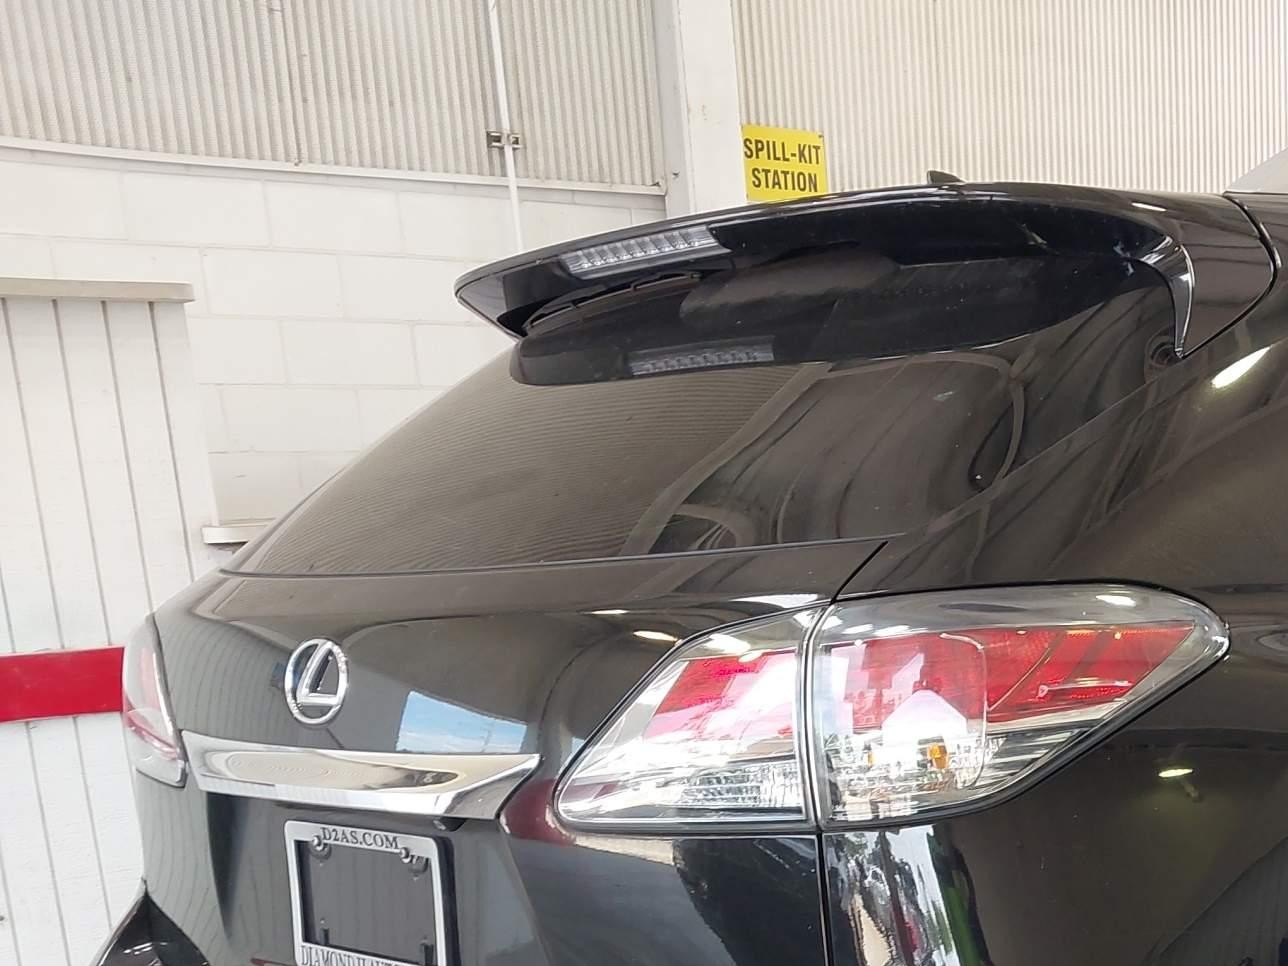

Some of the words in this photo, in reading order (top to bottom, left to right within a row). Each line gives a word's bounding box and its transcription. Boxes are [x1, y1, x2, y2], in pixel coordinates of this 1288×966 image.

[743, 138, 821, 165] SPILL-KIT
[751, 168, 818, 193] STATION
[320, 826, 400, 850] D2AS.COM
